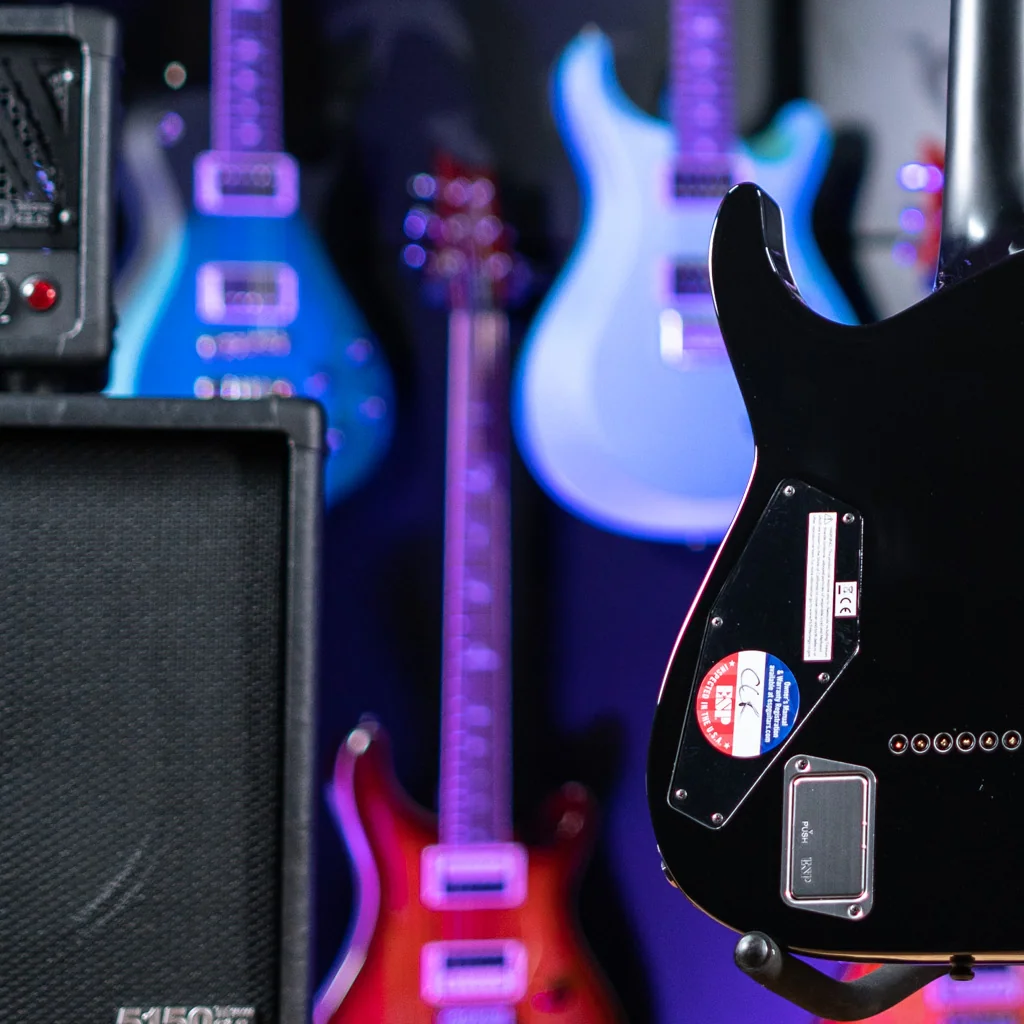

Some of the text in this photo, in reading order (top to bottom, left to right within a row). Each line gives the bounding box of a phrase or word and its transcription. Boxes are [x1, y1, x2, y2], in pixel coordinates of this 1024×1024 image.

[700, 664, 729, 745] INSPECTED IN THE U.S.A.
[715, 685, 733, 725] ESP
[774, 675, 783, 702] Warranty
[765, 698, 773, 743] espguitars.com
[773, 702, 781, 738] Registration
[801, 821, 809, 844] PUSH
